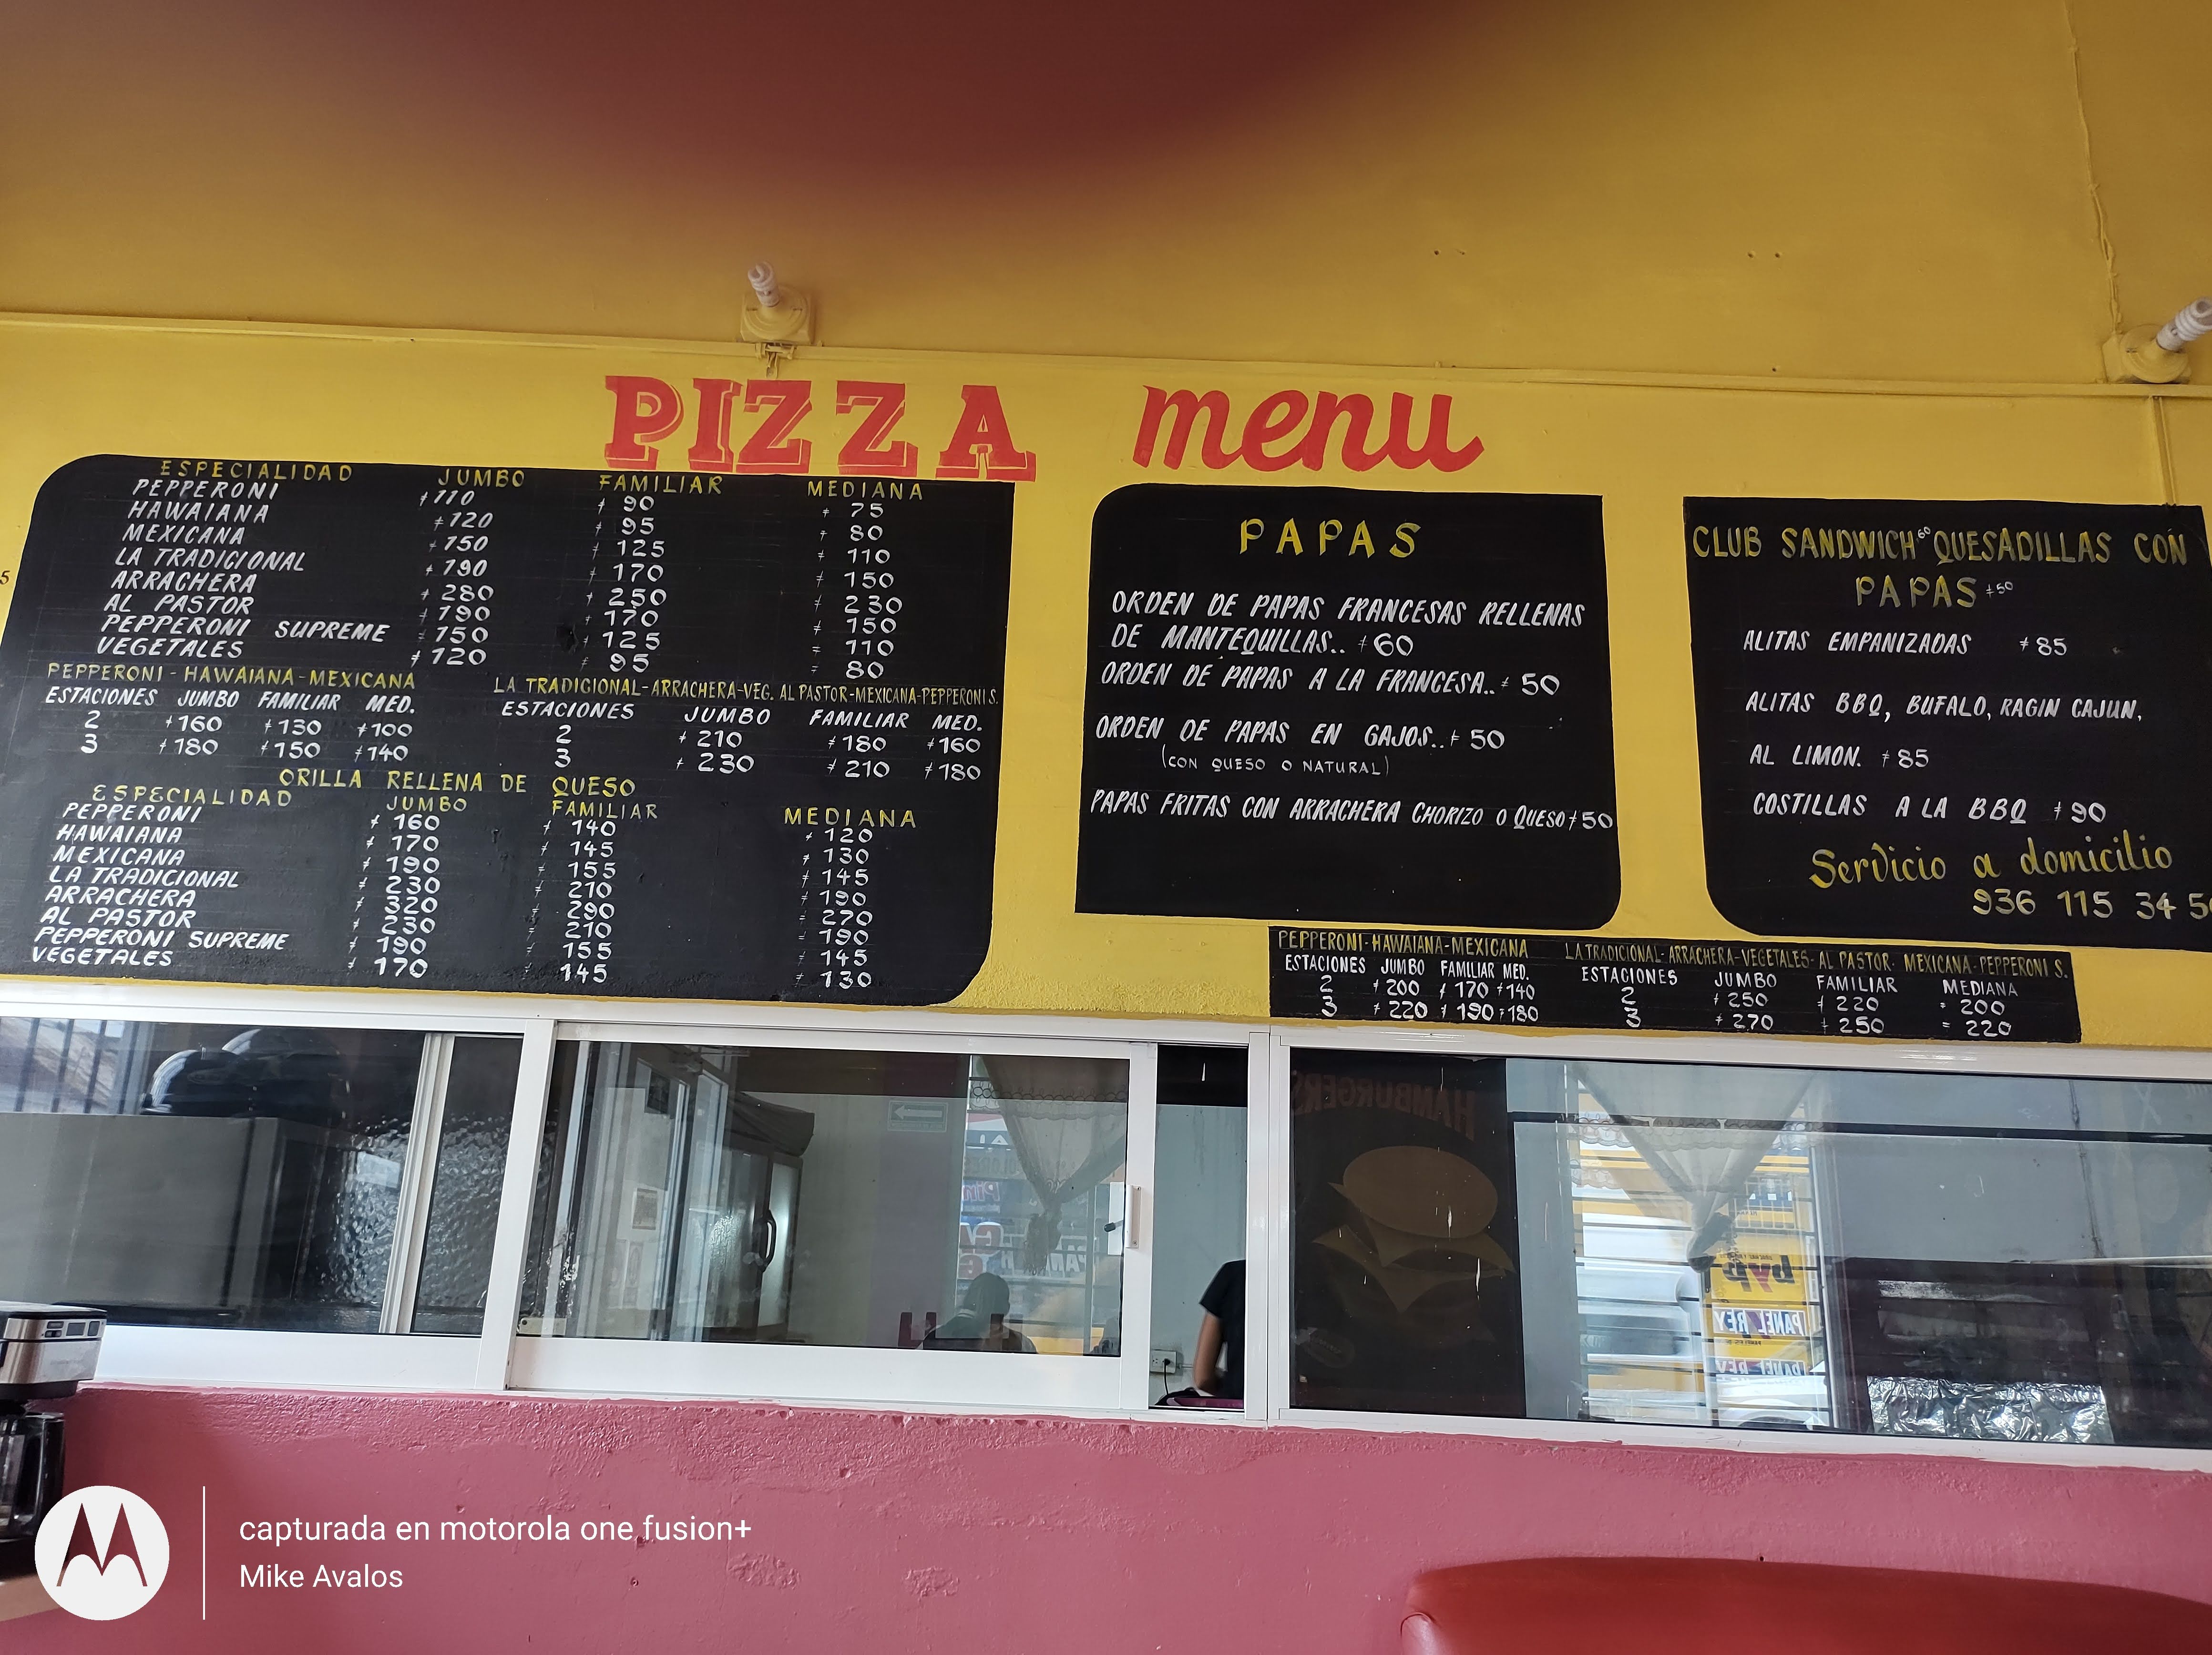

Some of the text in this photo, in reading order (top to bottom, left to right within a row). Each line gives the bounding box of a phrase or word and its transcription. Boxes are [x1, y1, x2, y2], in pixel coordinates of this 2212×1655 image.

[604, 375, 1485, 482] PIZZA menu
[132, 479, 278, 500] PEPPERONI
[160, 460, 922, 500] ESPECIALIDAD JUMBO FAMILIAR MEDIANA
[127, 501, 269, 523] HAWAIANA
[122, 523, 245, 545] MEXICANA
[1239, 518, 1421, 559] PAPAS
[1693, 526, 2187, 566] CLUB SANDWICH QUESADILLAS CON
[115, 547, 305, 572] LA TRADICIONAL
[111, 570, 257, 593] ARRACHERA
[1855, 574, 1976, 608] PAPAS
[103, 593, 254, 615] AL PASTOR
[1112, 591, 1585, 627] ORDEN DE PAPAS FRANCESAS RELLENAS
[101, 614, 390, 642] PEPPERONI SUPREME
[1111, 623, 1143, 648] DE
[97, 636, 244, 658] VEGETALES
[1743, 630, 1810, 651] ALITAS
[1828, 632, 1972, 654] EMPANIZADAS
[493, 676, 515, 693] LA
[779, 684, 795, 701] AL
[1101, 661, 1173, 685] ORDEN
[1182, 664, 1213, 687] DE
[1221, 665, 1293, 690] PAPAS
[1308, 668, 1328, 691] A
[1335, 668, 1365, 692] LA
[45, 686, 158, 706] ESTACIONES
[177, 689, 239, 708] JUMBO
[257, 691, 341, 711] FAMILIAR
[1745, 691, 1815, 713] ALITAS
[2000, 698, 2061, 718] RAGIN
[84, 710, 101, 729] 2
[502, 701, 635, 720] ESTACIONES
[684, 706, 770, 725] JUMBO
[809, 709, 909, 728] FAMILIAR
[556, 725, 572, 744] 2
[1096, 715, 1165, 739] ORDEN
[1179, 719, 1210, 742] DE
[1224, 719, 1290, 744] PAPAS
[1311, 723, 1342, 745] EN
[80, 733, 98, 754] 3
[1750, 744, 1774, 765] AL
[554, 748, 571, 768] 3
[1211, 758, 1265, 772] QUESO
[1281, 760, 1292, 771] O
[279, 768, 635, 797] ORILLA RELLENA DE QUESO
[62, 802, 202, 824] PEPPERONI
[92, 784, 916, 828] ESPECIALIDAD JUMBO FAMILIAR MEDIANA
[1091, 789, 1149, 815] PAPAS
[1160, 793, 1230, 818] FRITAS
[1242, 796, 1280, 819] CON
[1289, 798, 1401, 823] ARRACHERA
[1412, 802, 1484, 825] CHORIZO
[1496, 808, 1507, 826] O
[1513, 805, 1566, 829] QUESO
[1753, 792, 1867, 816] COSTILLAS
[1895, 796, 1910, 817] A
[1921, 797, 1947, 818] LA
[1968, 797, 2027, 824] BBQ
[56, 824, 182, 844] HAWAIANA
[52, 844, 185, 866] MEXICANA
[1809, 829, 2172, 889] Servicio a domicilio
[49, 865, 239, 888] LA TRADICIONAL
[44, 885, 196, 908] ARRACHERA
[1973, 889, 2212, 919] 936 115 34 5
[40, 906, 196, 929] AL PASTOR
[34, 926, 290, 950] PEPPERONI SUPREME
[32, 946, 174, 967] VEGETALES
[1286, 954, 1366, 974] ESTACIONES
[1381, 958, 1425, 976] JUMBO
[1441, 960, 1495, 979] FAMILIAR
[1565, 942, 1583, 960] LA
[1819, 950, 1833, 970] AL
[1320, 974, 1333, 993] 2
[1581, 966, 2018, 996] ESTACIONES JUMBO FAMILIAR MEDIANA
[1321, 995, 1337, 1017] 3
[1621, 986, 1636, 1005] 2
[1624, 1006, 1641, 1028] 3
